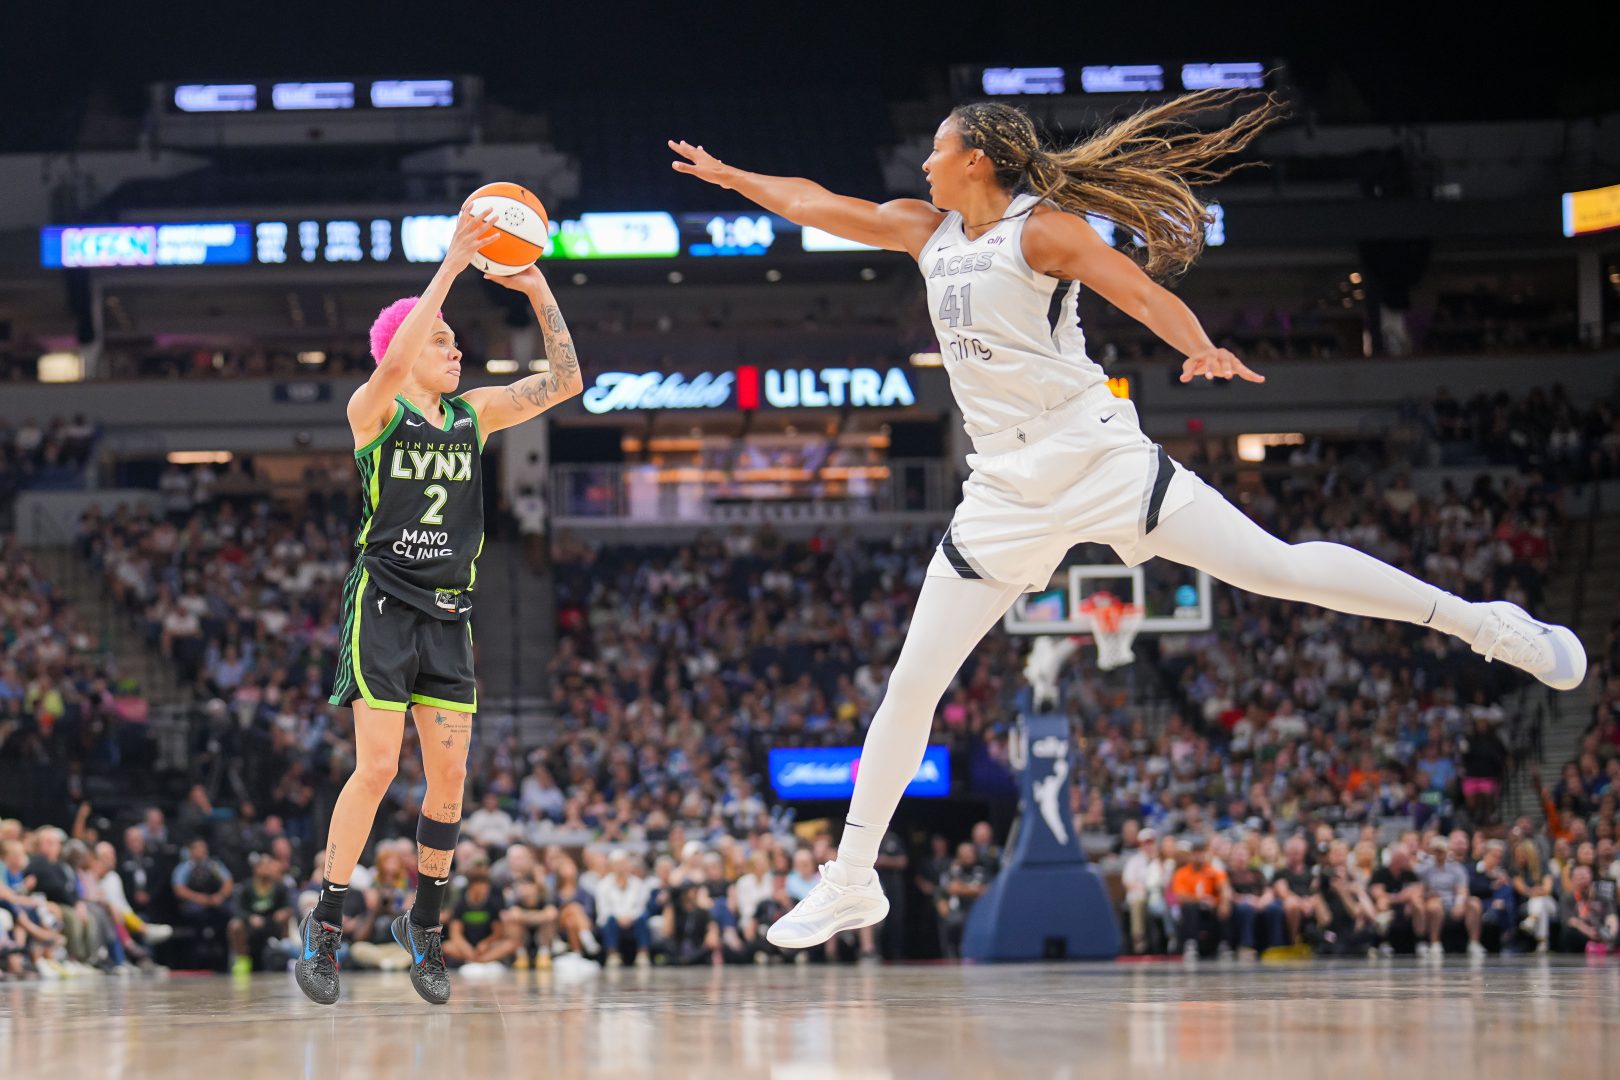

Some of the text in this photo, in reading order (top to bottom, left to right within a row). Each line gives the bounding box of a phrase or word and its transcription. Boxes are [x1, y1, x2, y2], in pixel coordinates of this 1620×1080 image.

[706, 216, 775, 248] 1:04
[987, 236, 1007, 246] ally
[929, 252, 996, 279] ACES
[939, 283, 973, 328] 41
[765, 367, 915, 408] ULTRA
[395, 440, 473, 451] MINNESOTA
[391, 449, 472, 481] LYNX
[420, 484, 448, 525] 2
[392, 540, 453, 561] CLINIC
[402, 529, 448, 546] MAYO
